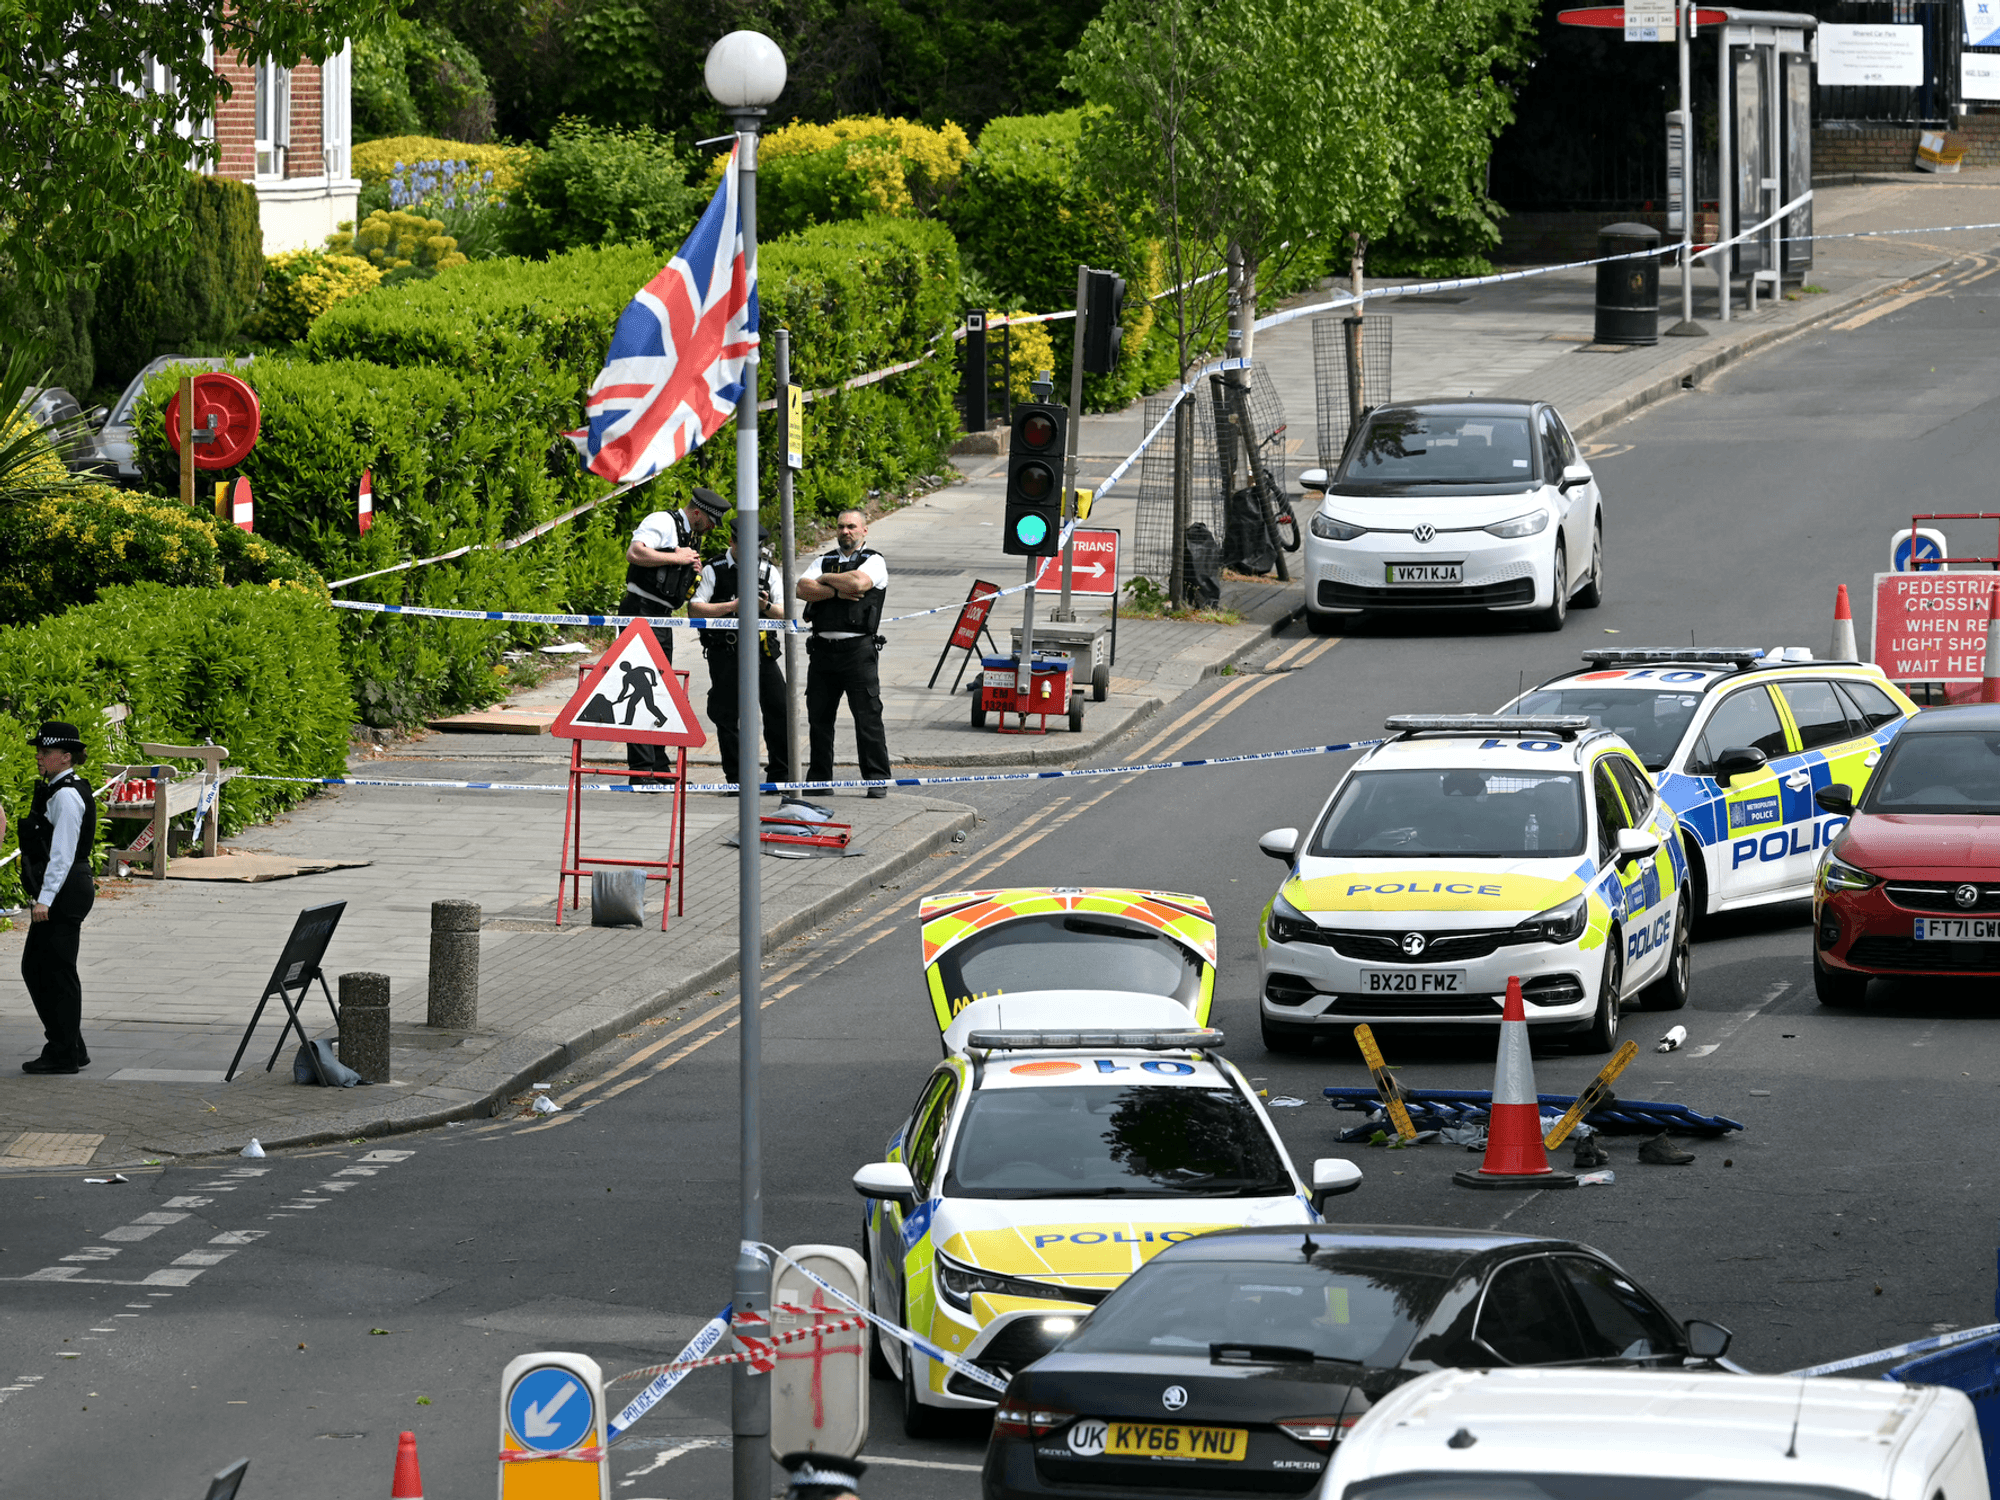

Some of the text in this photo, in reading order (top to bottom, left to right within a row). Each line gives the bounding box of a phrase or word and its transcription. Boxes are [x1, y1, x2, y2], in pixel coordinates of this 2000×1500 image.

[1398, 567, 1457, 580] VK71 KJA
[1897, 580, 1995, 595] PEDESTRIA
[1905, 597, 1989, 611] CROSSIN
[1906, 618, 1988, 632] WHEN RE
[1892, 637, 1987, 651] LIGHT SHO
[1897, 660, 1940, 673] WAIT
[1751, 810, 1773, 821] POLICE
[1732, 817, 1849, 870] POLIC
[1346, 883, 1502, 897] POLICE
[1930, 920, 2000, 937] FT71 GW
[1626, 910, 1671, 966] POLICE
[1370, 973, 1458, 991] BX20 FMZ
[1034, 1231, 1194, 1248] POLIC
[622, 1391, 655, 1423] POLICE
[649, 1374, 672, 1398] LINE
[693, 1325, 720, 1355] CROSS
[1073, 1425, 1236, 1454] UK KY66 YNU
[1272, 1460, 1320, 1470] SUPERB
